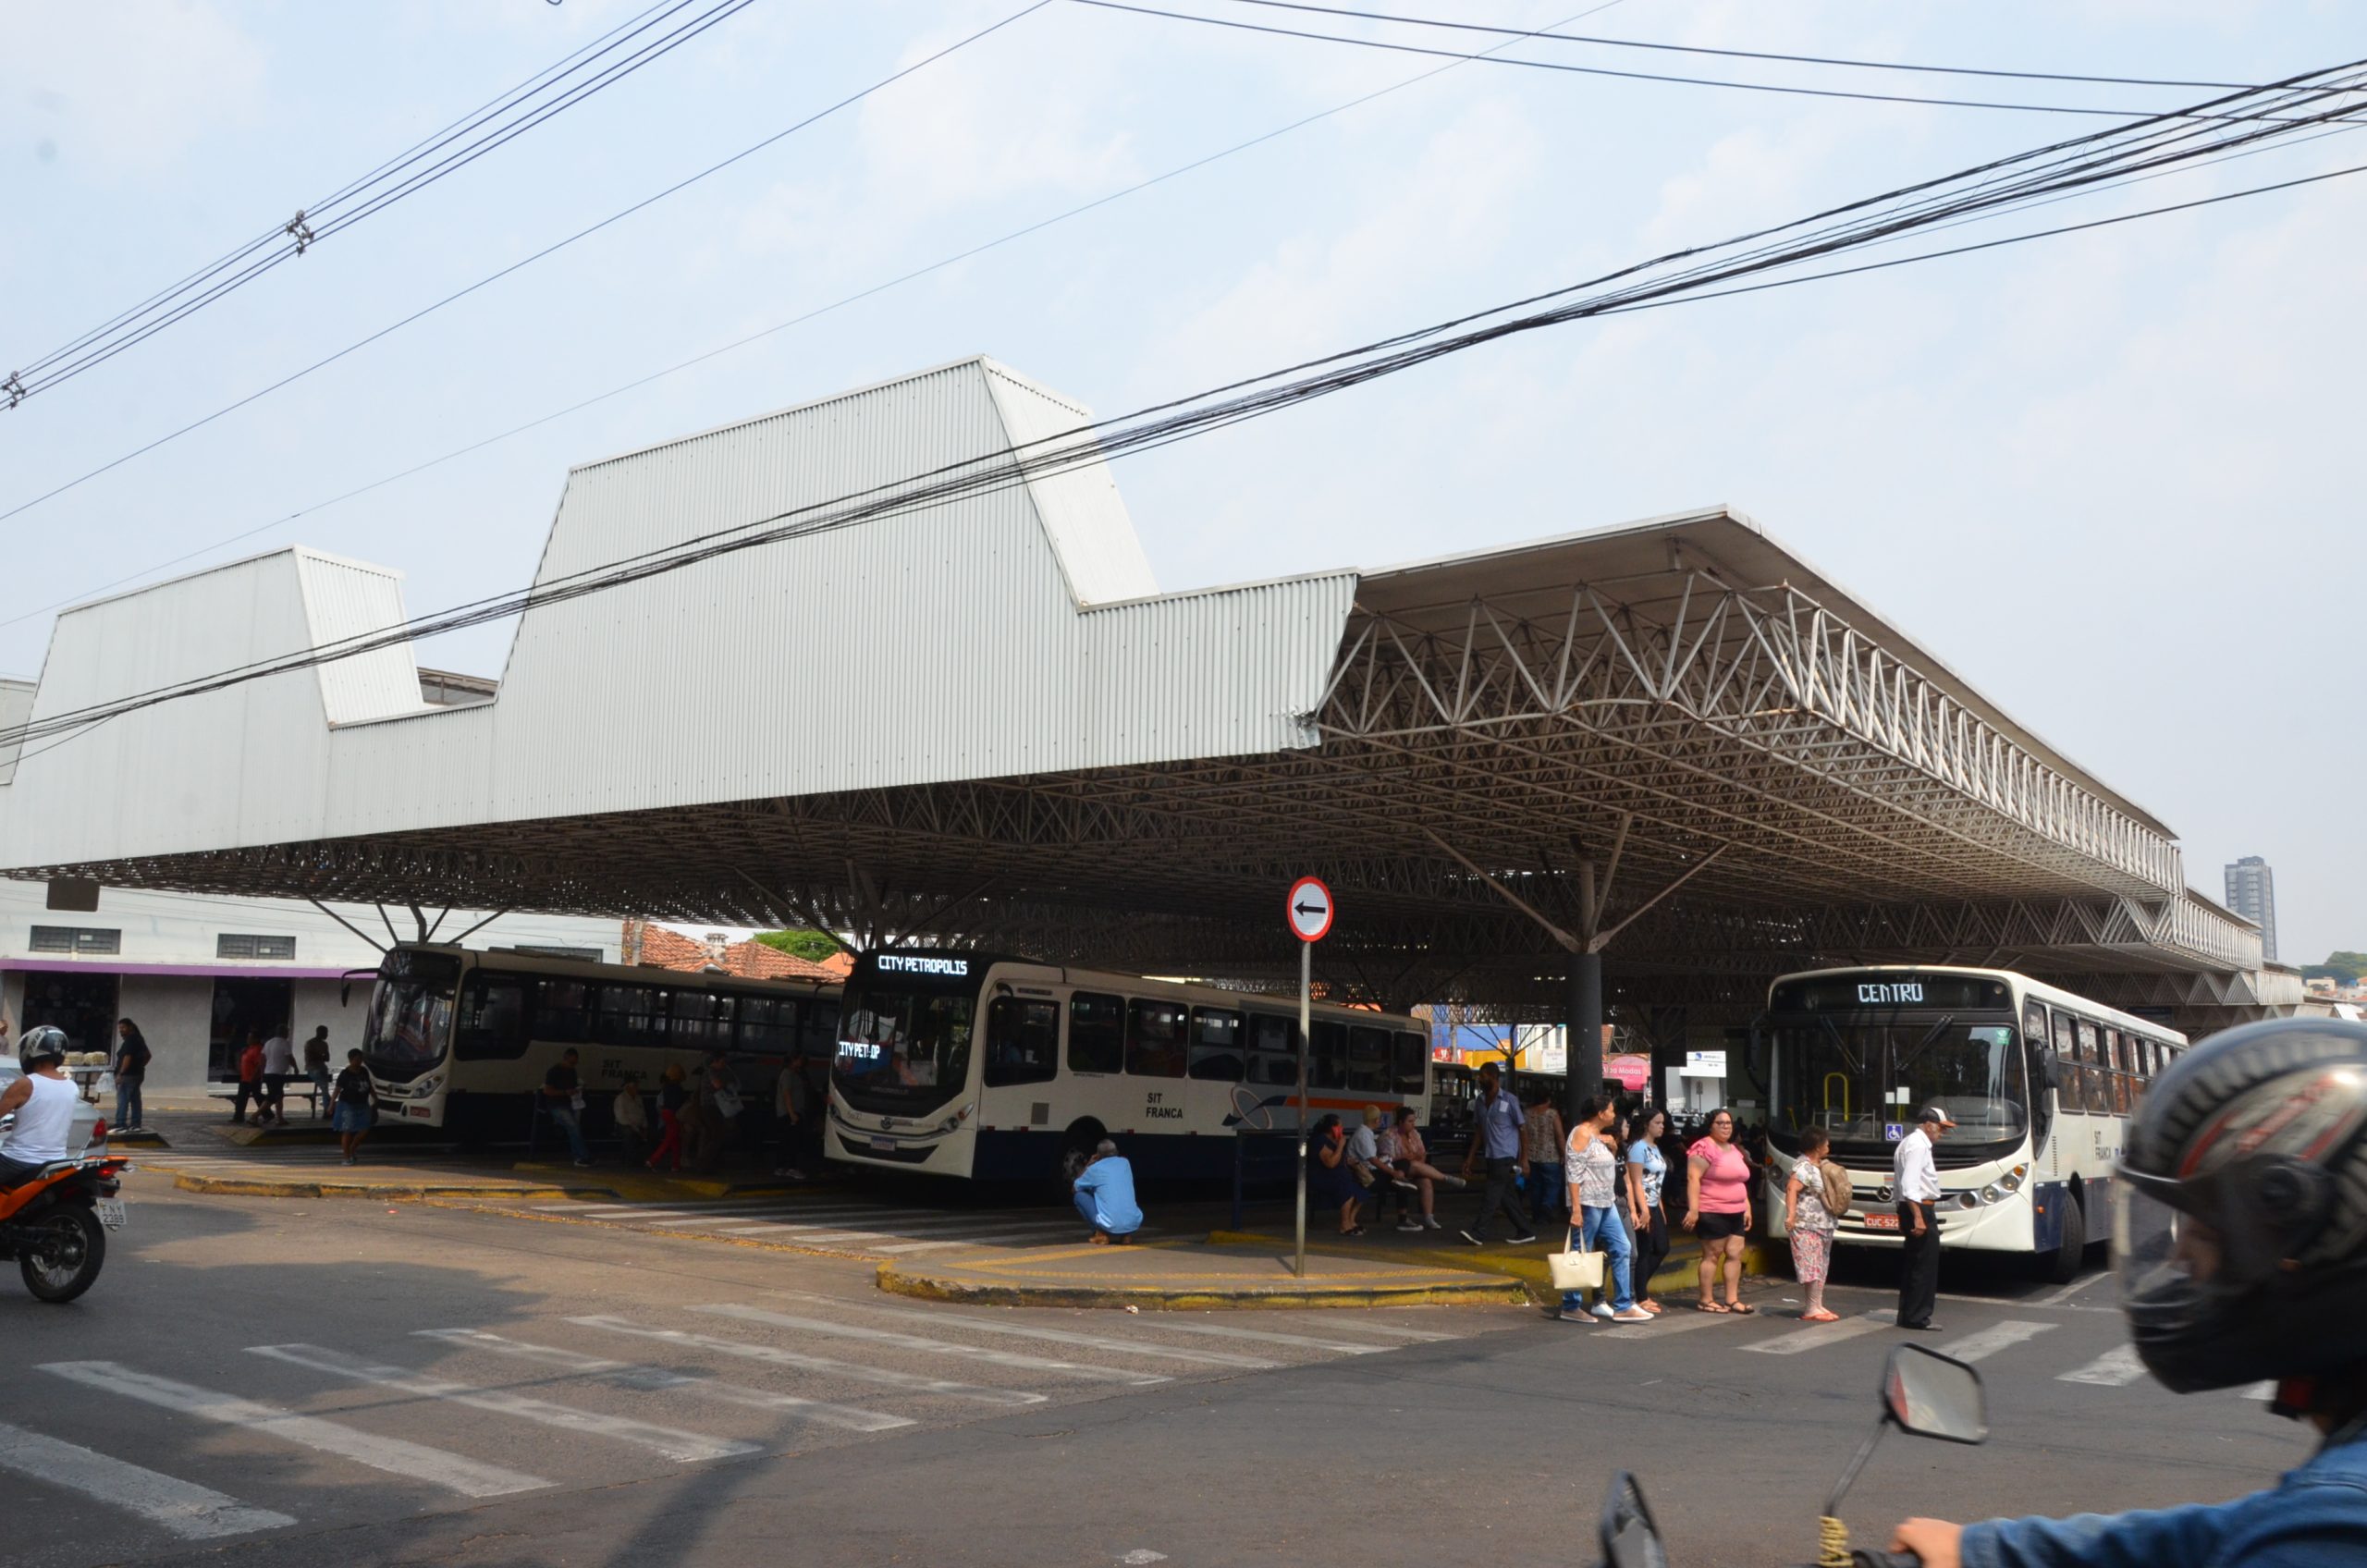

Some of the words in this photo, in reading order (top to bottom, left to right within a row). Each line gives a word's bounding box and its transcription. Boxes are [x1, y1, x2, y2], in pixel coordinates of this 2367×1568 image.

[878, 955, 903, 971] CITY
[905, 957, 968, 975] PETROPOLIS
[1858, 984, 1923, 1002] CENTRO
[838, 1041, 853, 1057] ITY
[854, 1042, 880, 1060] PETOP
[1147, 1092, 1163, 1104] SIT
[1146, 1107, 1184, 1119] FRANCA
